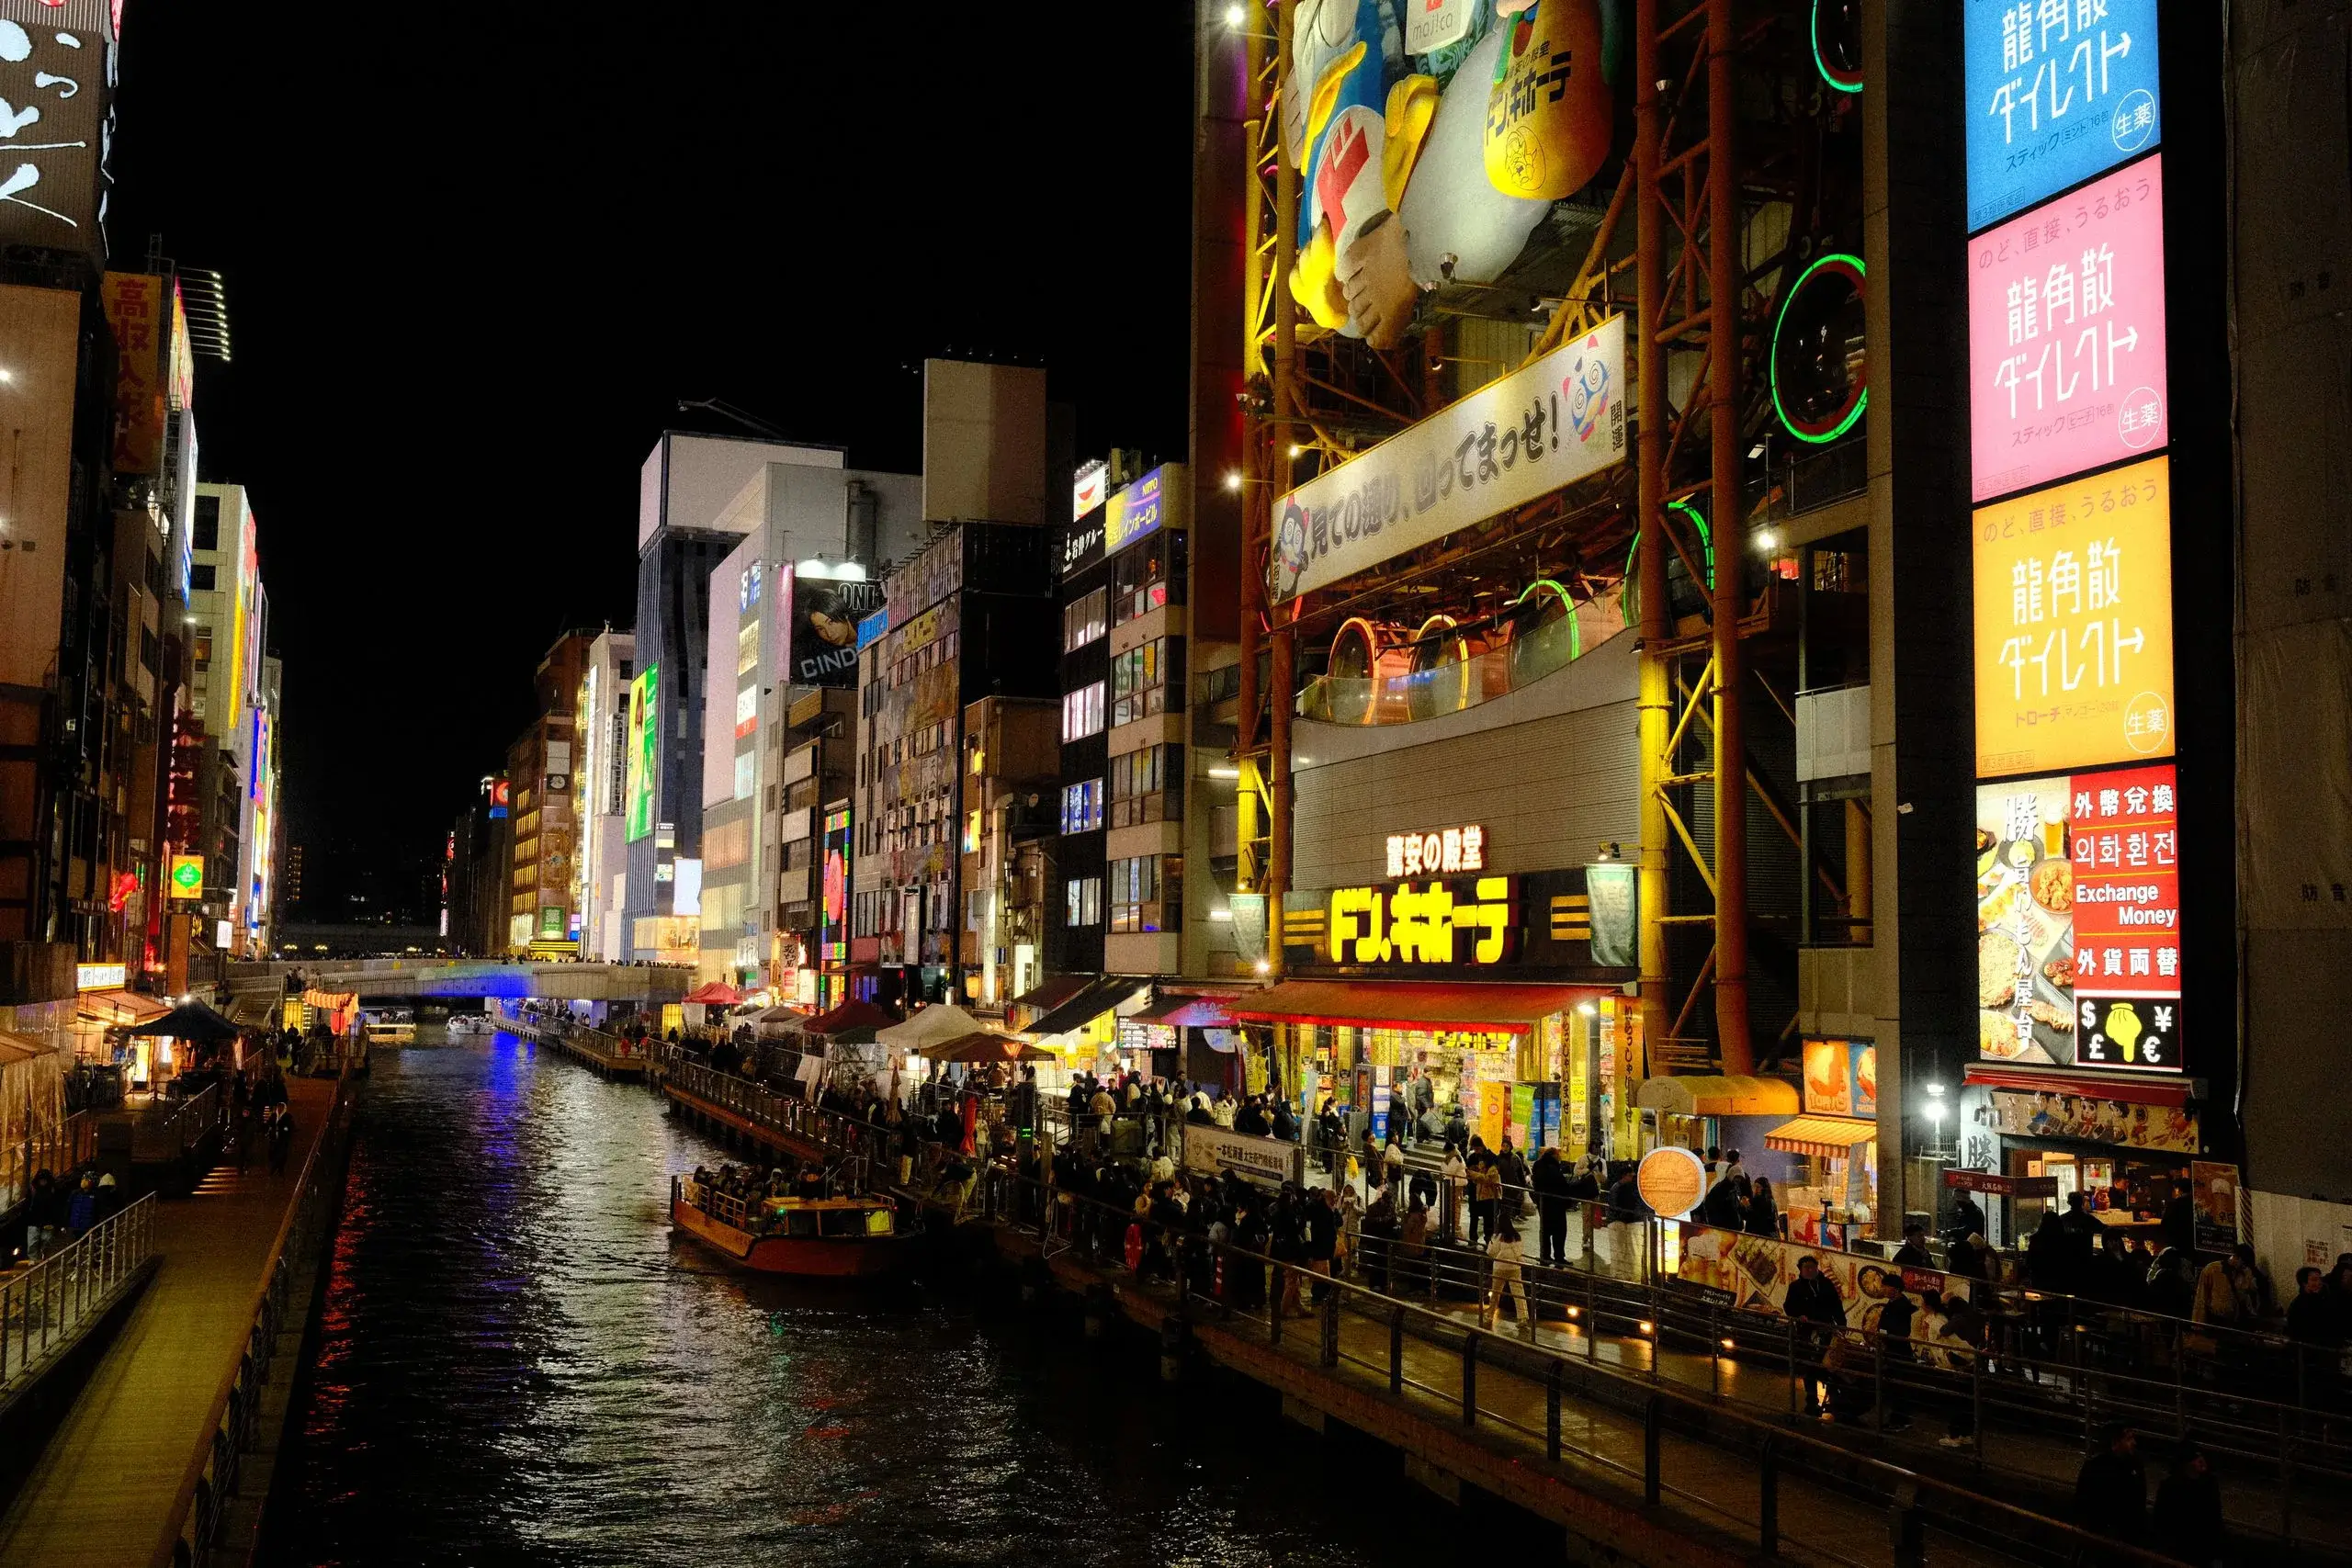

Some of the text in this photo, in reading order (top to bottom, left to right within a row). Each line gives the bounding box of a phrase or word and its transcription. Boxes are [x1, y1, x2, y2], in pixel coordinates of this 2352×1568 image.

[1989, 31, 2132, 144] ダイレクト
[2115, 102, 2154, 140] 生薬
[2006, 130, 2061, 173] スティック
[2006, 243, 2115, 346] 龍角散
[1994, 325, 2138, 419] ダイレクト
[2011, 416, 2065, 448] スティック
[2121, 400, 2159, 434] 生薬
[2012, 536, 2120, 626] 龍角散
[1998, 618, 2145, 700] ダイレクト
[2128, 709, 2165, 736] 生薬
[2075, 784, 2175, 819] 外幣兌換
[1386, 825, 1483, 878] 驚安の殿堂
[2075, 829, 2176, 869] 외화환전
[2075, 883, 2159, 904] Exchange
[2119, 907, 2177, 929] Money
[2077, 948, 2177, 976] 外貨両替
[2081, 1000, 2173, 1032] $ ¥
[2089, 1034, 2161, 1063] £ €
[1967, 1134, 1997, 1168] 勝
